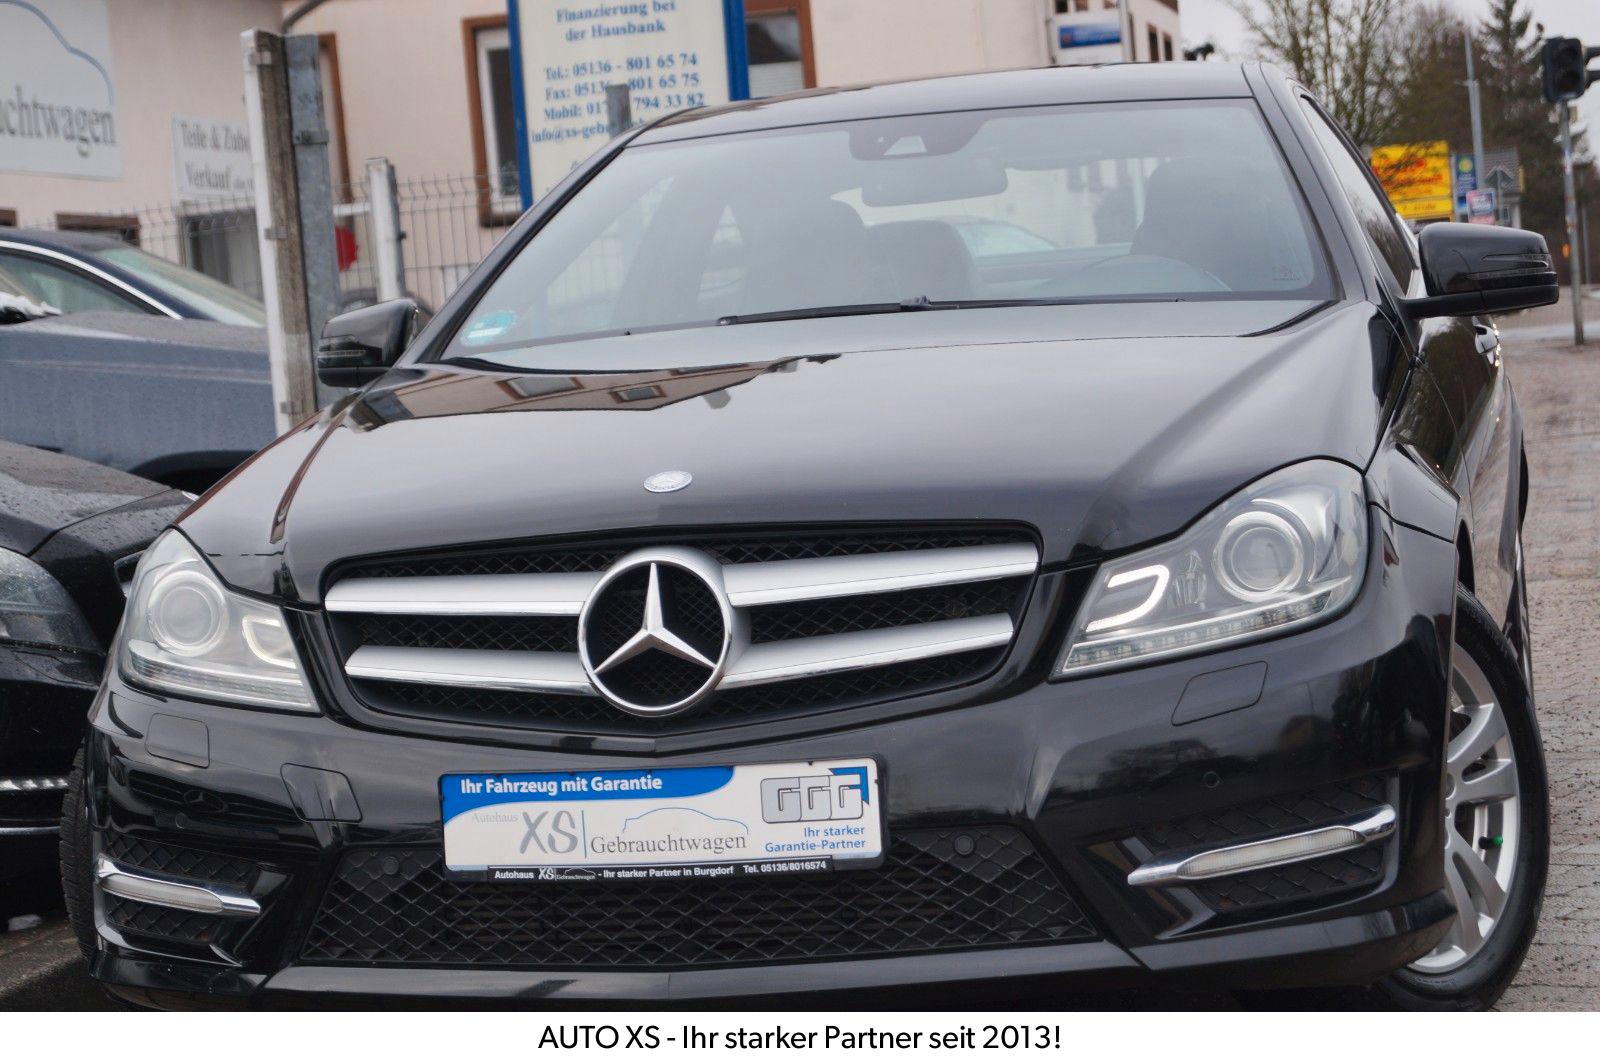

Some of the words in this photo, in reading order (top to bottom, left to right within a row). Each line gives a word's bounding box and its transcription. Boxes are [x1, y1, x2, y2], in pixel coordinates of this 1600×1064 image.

[556, 2, 647, 23] Finanzierung
[653, 0, 676, 12] bei
[566, 28, 586, 42] der
[592, 20, 665, 38] Hausbank
[545, 67, 569, 81] Tel.:
[573, 60, 611, 77] 05136
[626, 57, 650, 71] 801
[658, 54, 675, 68] 65
[680, 52, 697, 66] 74
[545, 86, 570, 101] Fax:
[629, 77, 653, 90] 801
[659, 74, 676, 88] 65
[682, 72, 700, 86] 75
[545, 105, 581, 121] Mobil:
[634, 96, 659, 110] 794
[664, 94, 682, 108] 33
[687, 93, 705, 107] 82
[181, 120, 207, 149] Teile
[210, 125, 221, 150] &
[185, 160, 232, 191] Verkauf
[461, 778, 482, 794] Ihr
[486, 777, 558, 796] Fahrzeug
[561, 776, 588, 792] mit
[591, 775, 663, 791] Garantie
[472, 812, 518, 824] Autohaus
[519, 810, 579, 854] XS
[804, 827, 820, 837] Ihr
[824, 825, 864, 836] starker
[590, 834, 746, 854] Gebrauchtwagen
[765, 839, 865, 854] Garantie-Partner
[494, 870, 534, 879] Autohaus
[538, 868, 554, 880] XS
[603, 870, 615, 878] Ihr
[616, 869, 646, 878] starker
[649, 868, 680, 877] Partner
[683, 868, 692, 876] in
[694, 866, 734, 877] Burgdorf
[742, 864, 758, 874] Tel.
[760, 860, 826, 872] 05136/8016574
